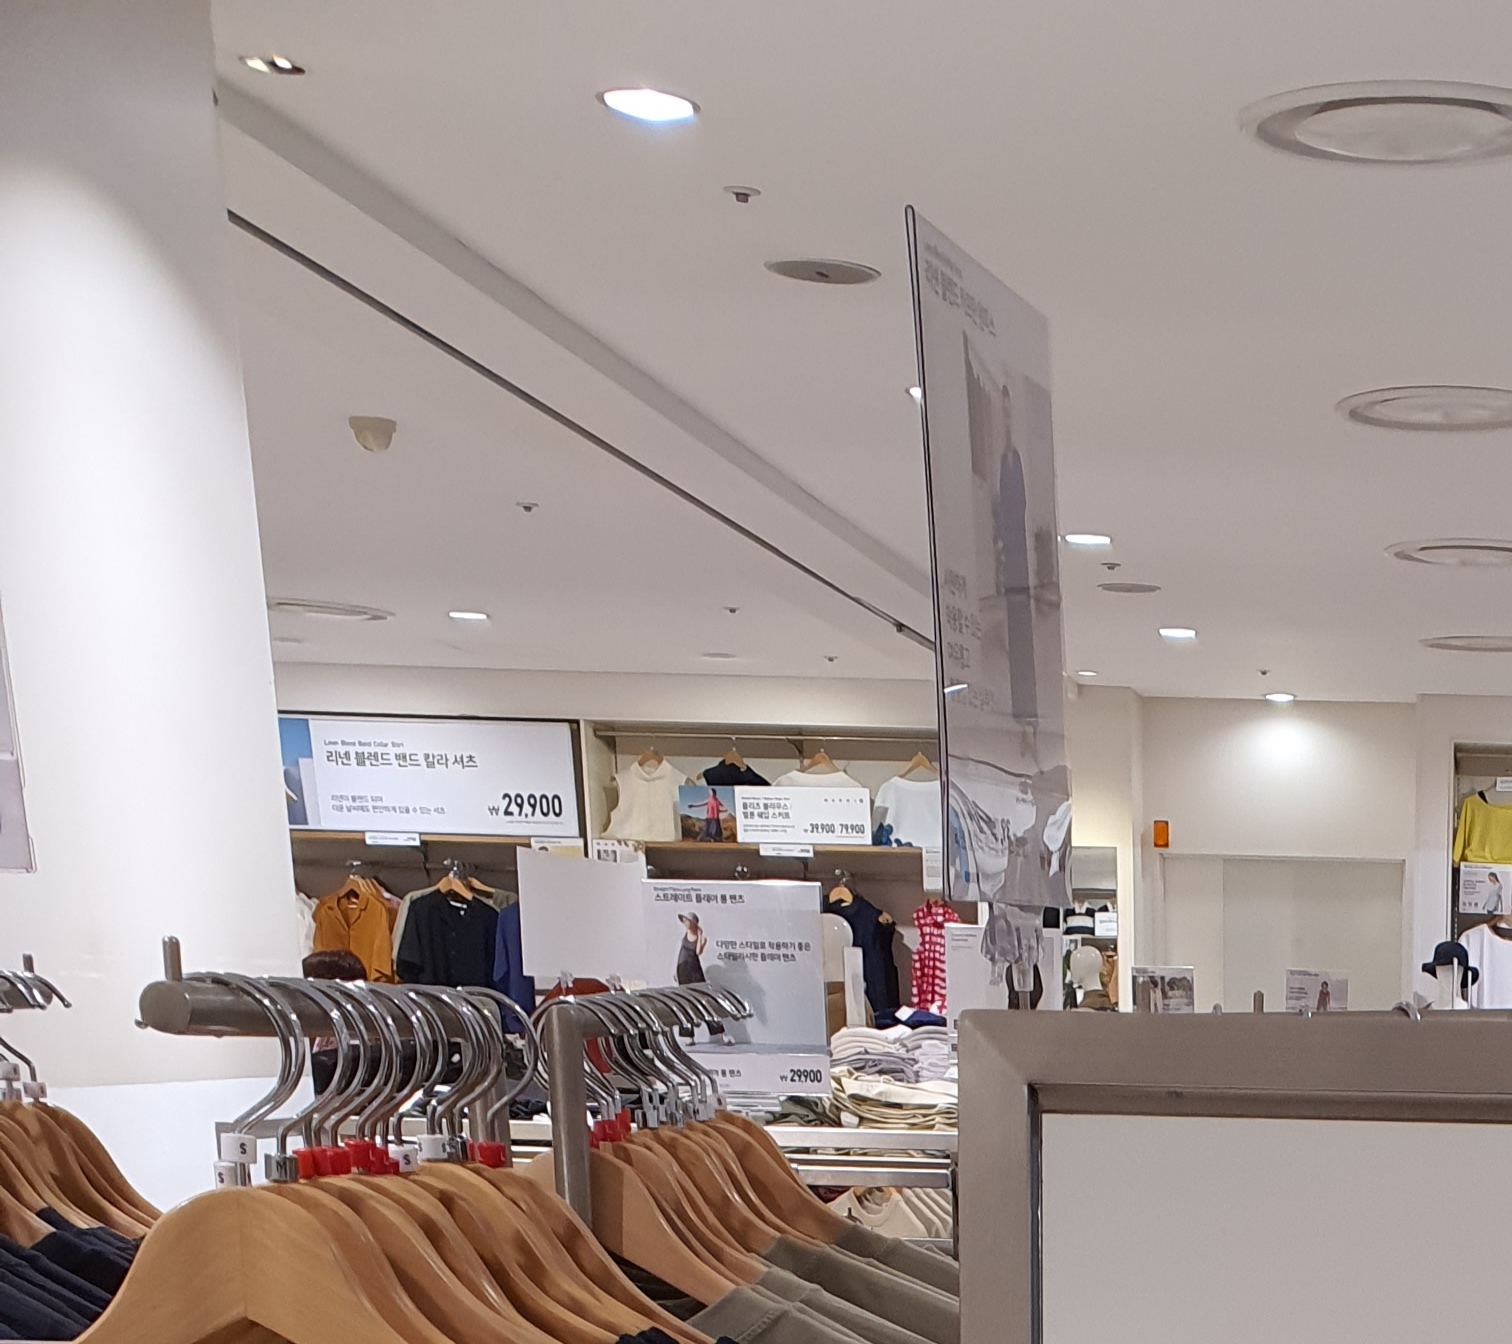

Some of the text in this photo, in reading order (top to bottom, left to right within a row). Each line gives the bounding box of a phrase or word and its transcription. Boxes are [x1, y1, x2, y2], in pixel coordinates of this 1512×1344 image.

[326, 750, 479, 769] 리넨 블렌드 밴드 칼라 셔츠
[729, 894, 745, 904] 팬츠
[240, 1142, 247, 1155] S
[403, 1153, 411, 1166] S
[217, 1171, 225, 1184] S
